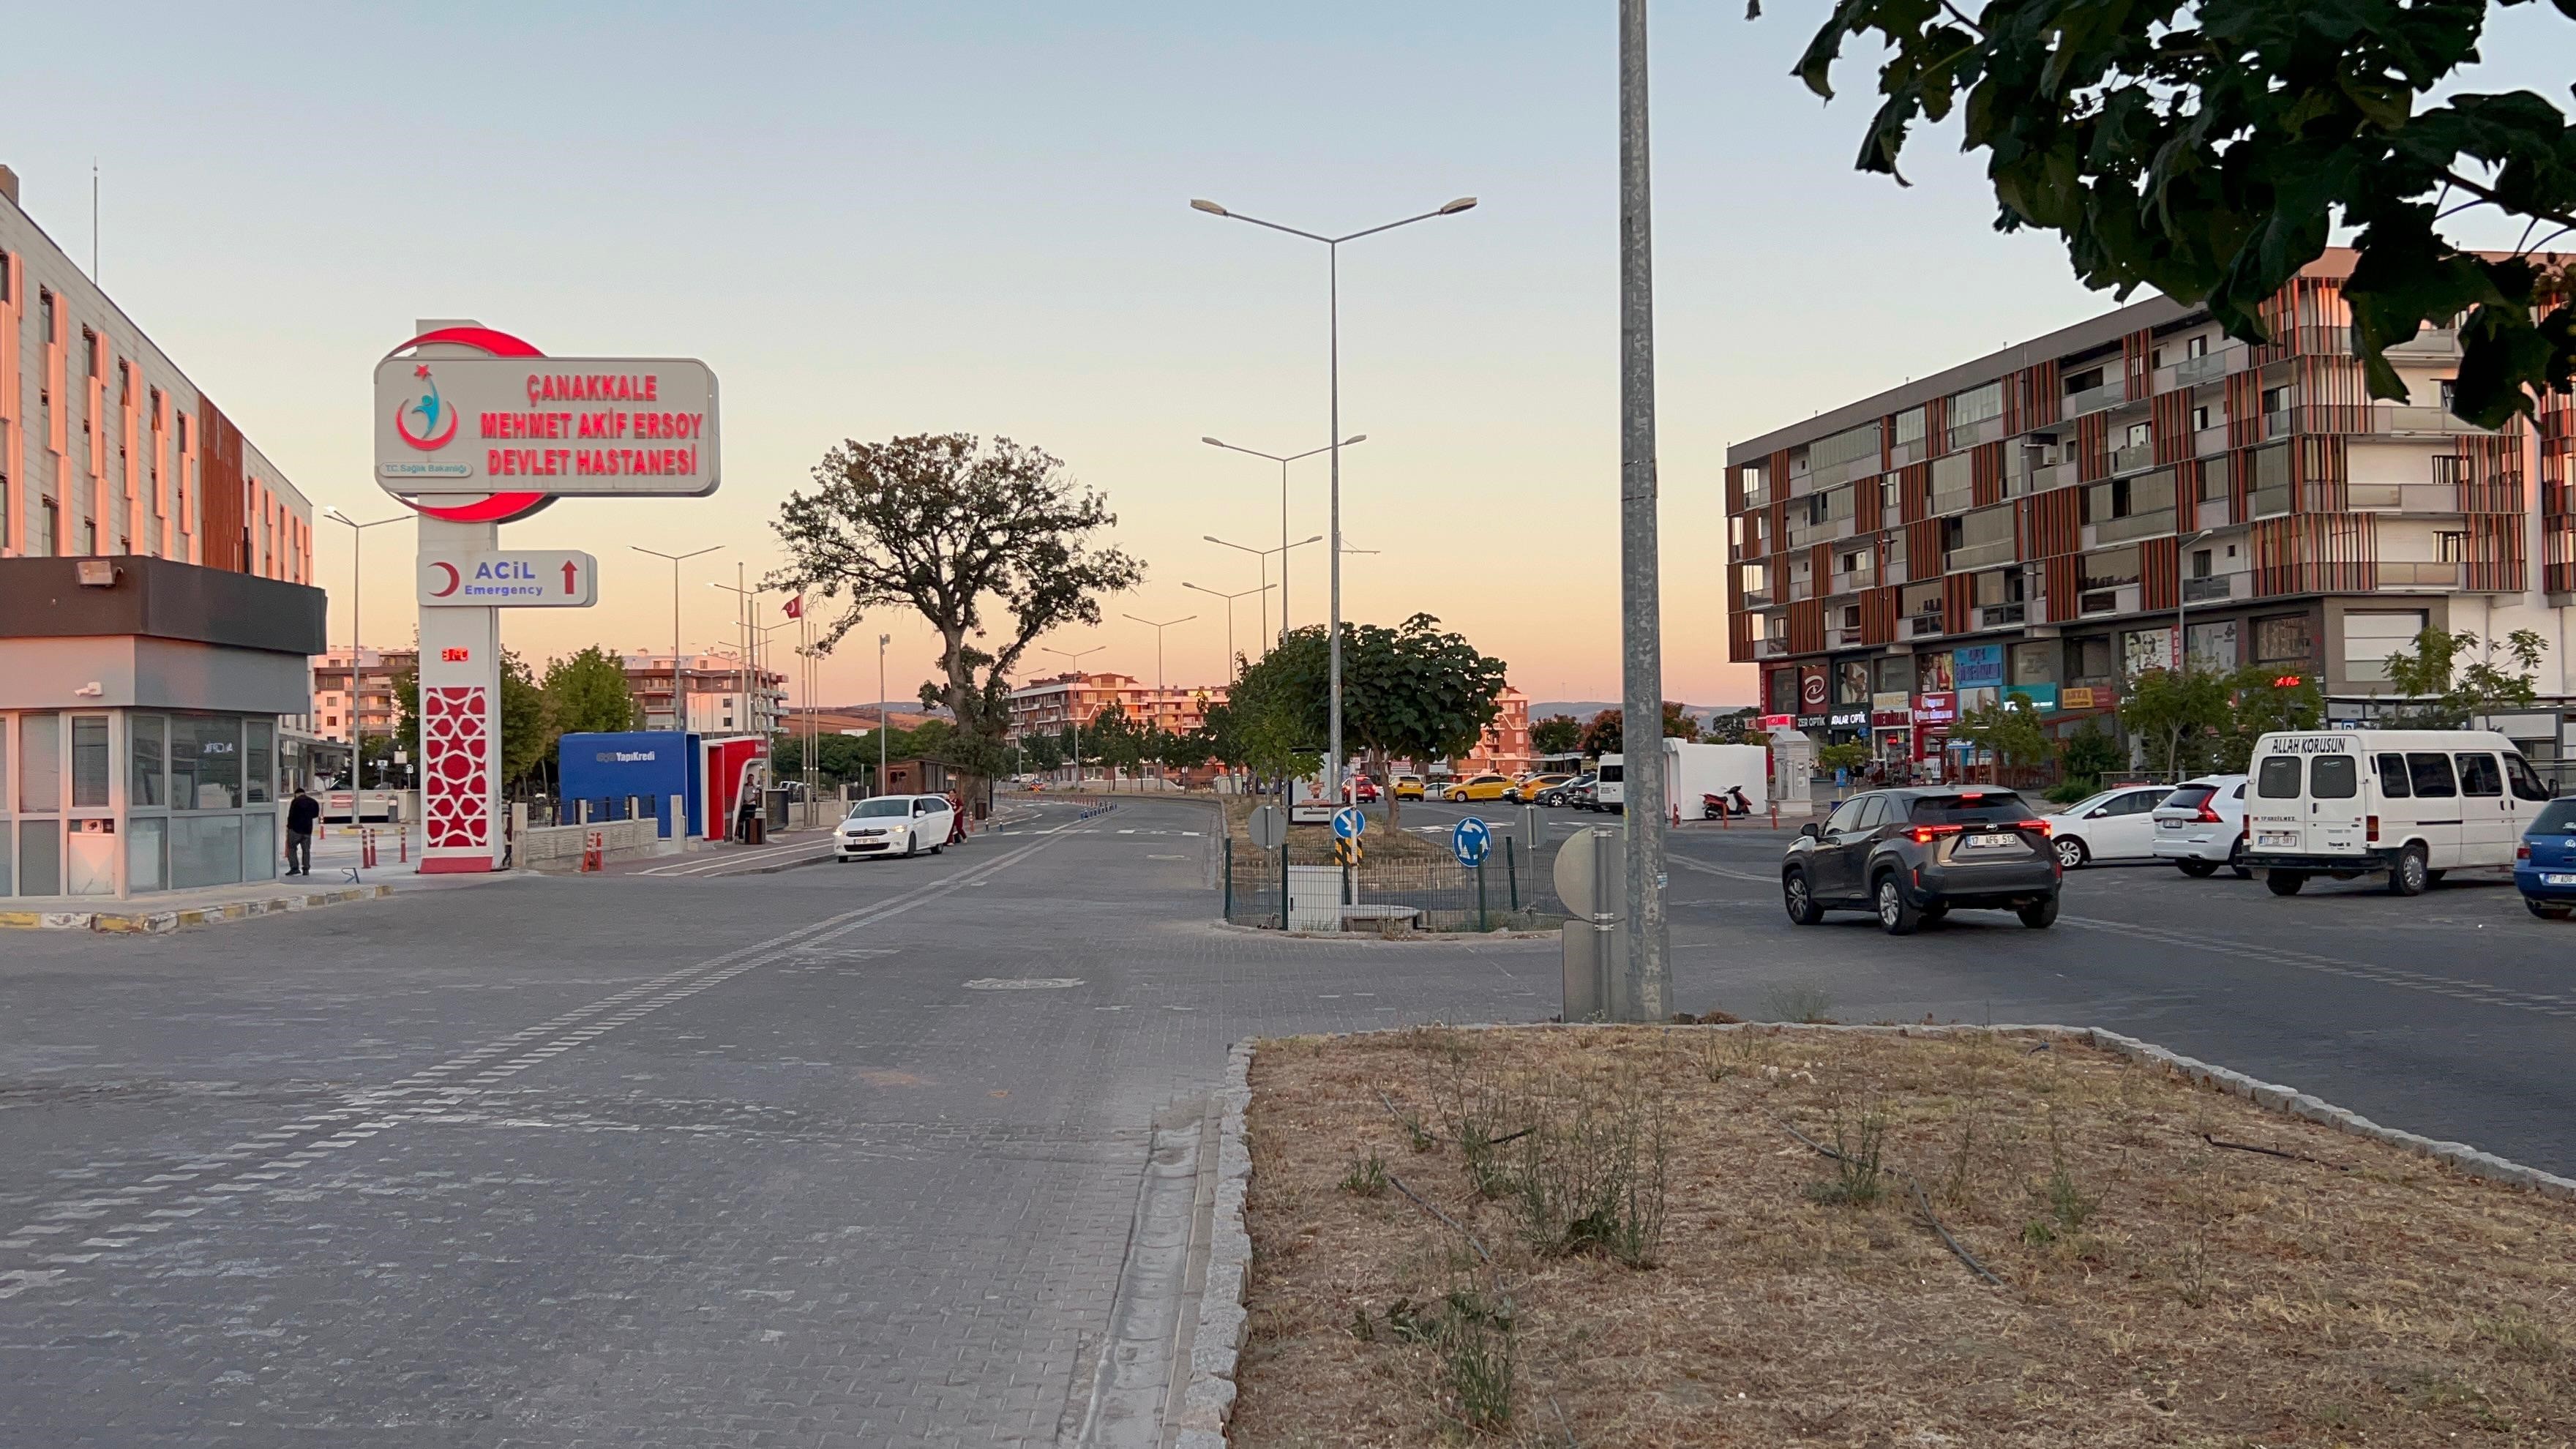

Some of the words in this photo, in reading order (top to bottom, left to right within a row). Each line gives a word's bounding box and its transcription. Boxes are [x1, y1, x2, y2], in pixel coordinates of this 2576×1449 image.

[527, 374, 656, 407] ÇANAKKALE
[481, 413, 572, 438] MEHMET
[577, 407, 627, 438] AKİF
[633, 413, 703, 438] ERSOY
[488, 449, 571, 476] DEVLET
[576, 443, 697, 476] HASTANESİ
[400, 464, 426, 474] Sağlık
[428, 464, 467, 474] Bakanlığı
[465, 585, 543, 596] Emergency
[1809, 714, 1825, 727] OPTİK
[1831, 715, 1849, 725] ATALAR
[1850, 711, 1866, 724] OPTİK
[2272, 738, 2299, 754] ALLAH
[2301, 738, 2345, 754] KORUSUN
